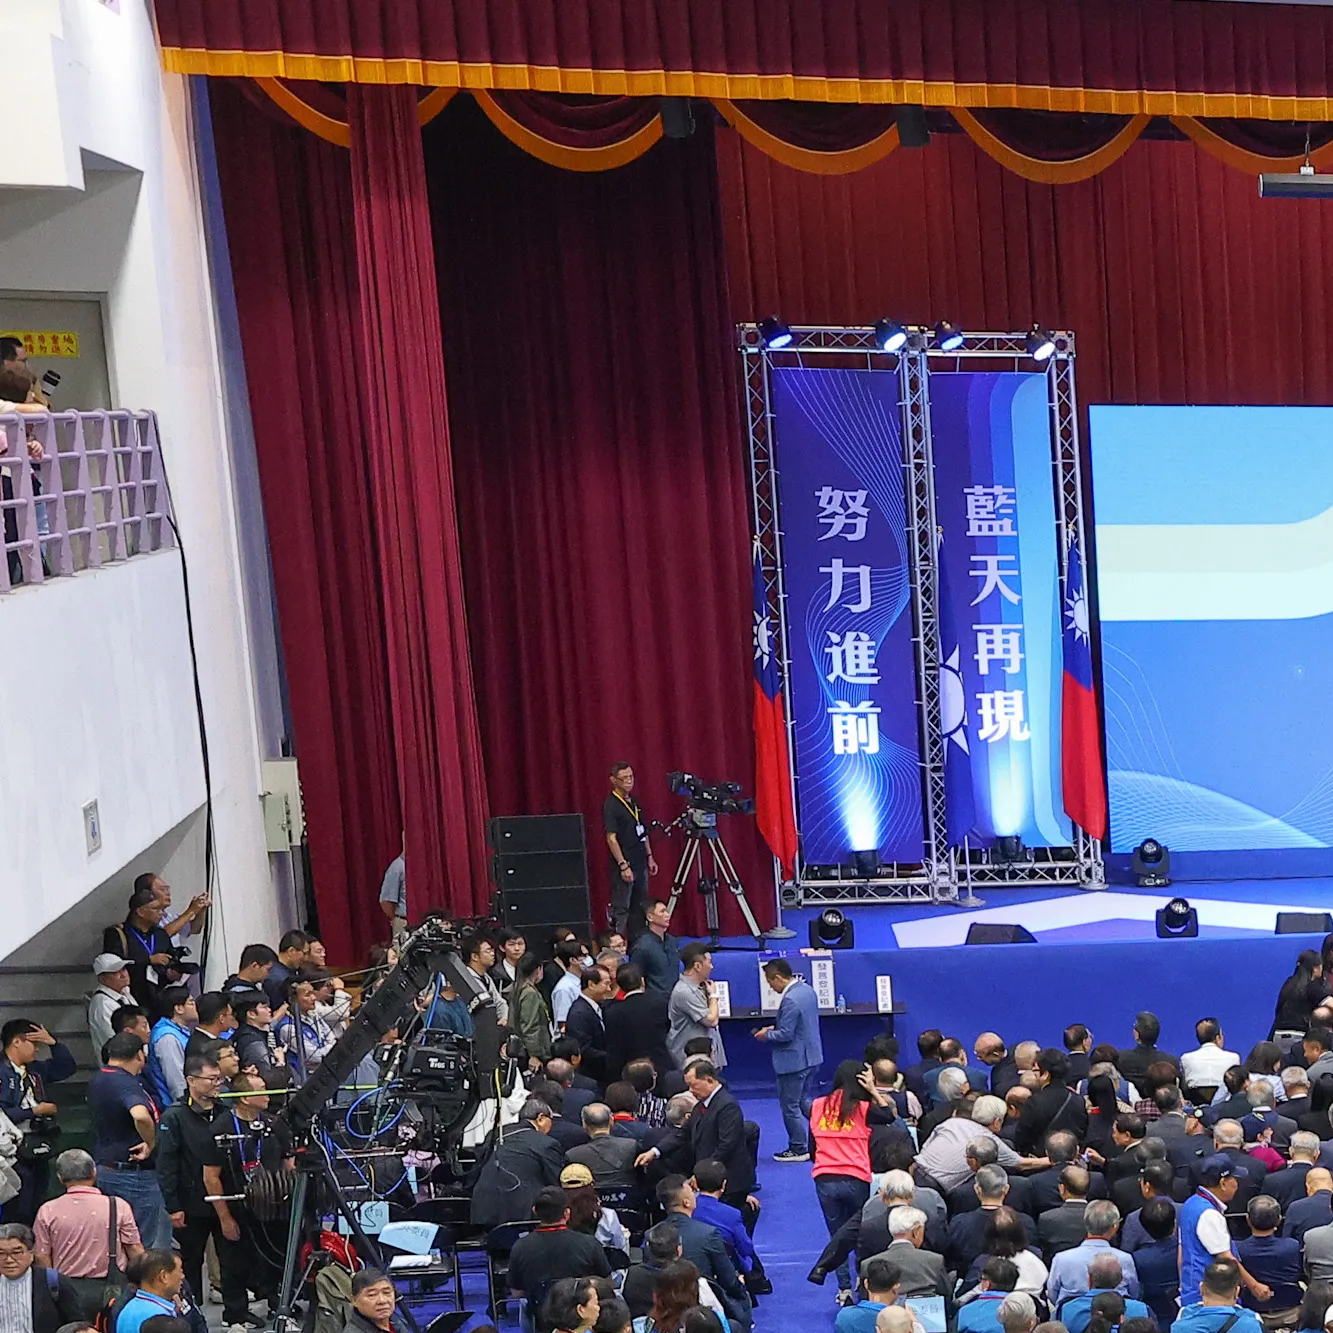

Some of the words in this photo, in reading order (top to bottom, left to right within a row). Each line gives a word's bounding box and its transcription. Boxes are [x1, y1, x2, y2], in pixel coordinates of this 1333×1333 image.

[815, 485, 882, 755] 努力進前
[963, 485, 1031, 743] 藍天再現
